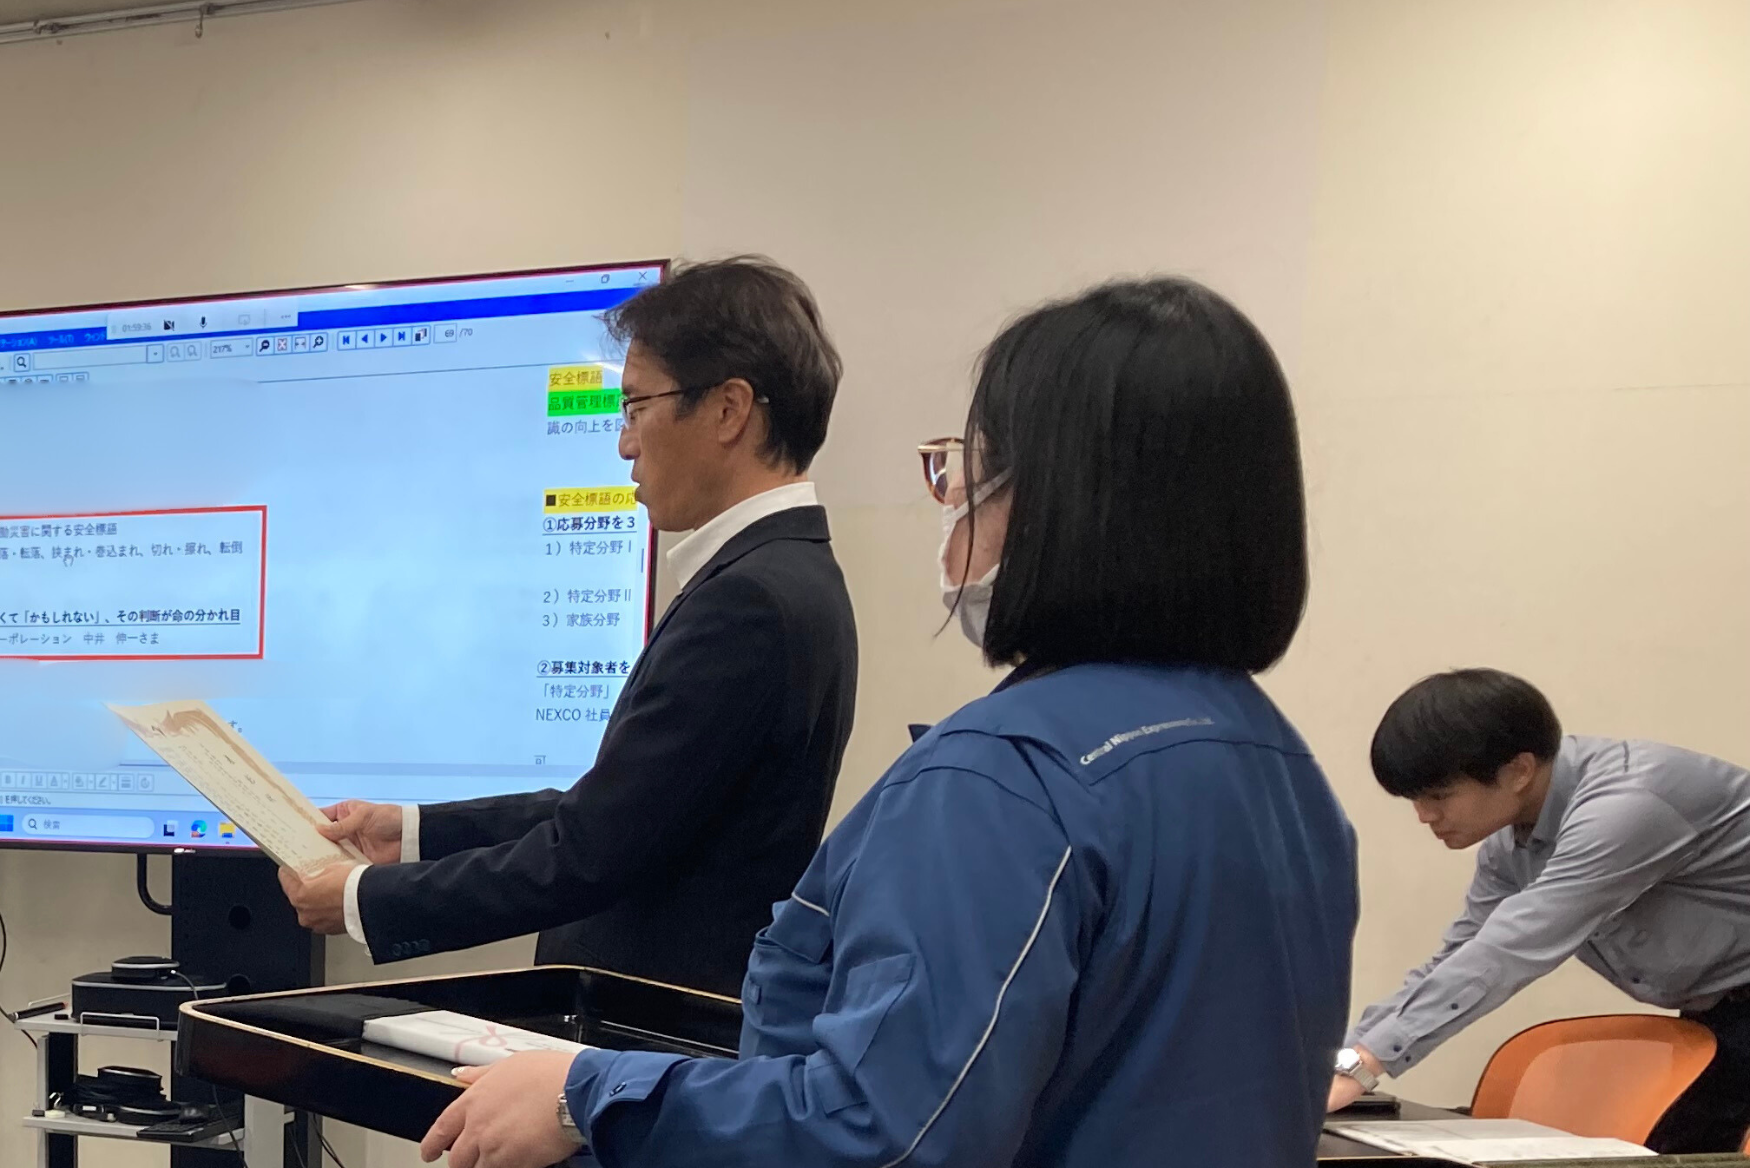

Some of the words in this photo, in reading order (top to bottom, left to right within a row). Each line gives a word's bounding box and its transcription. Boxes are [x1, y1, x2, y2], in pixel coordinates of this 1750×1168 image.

[549, 371, 603, 386] 安全標語
[548, 394, 622, 411] 品質管理標
[535, 708, 581, 721] NEXCO
